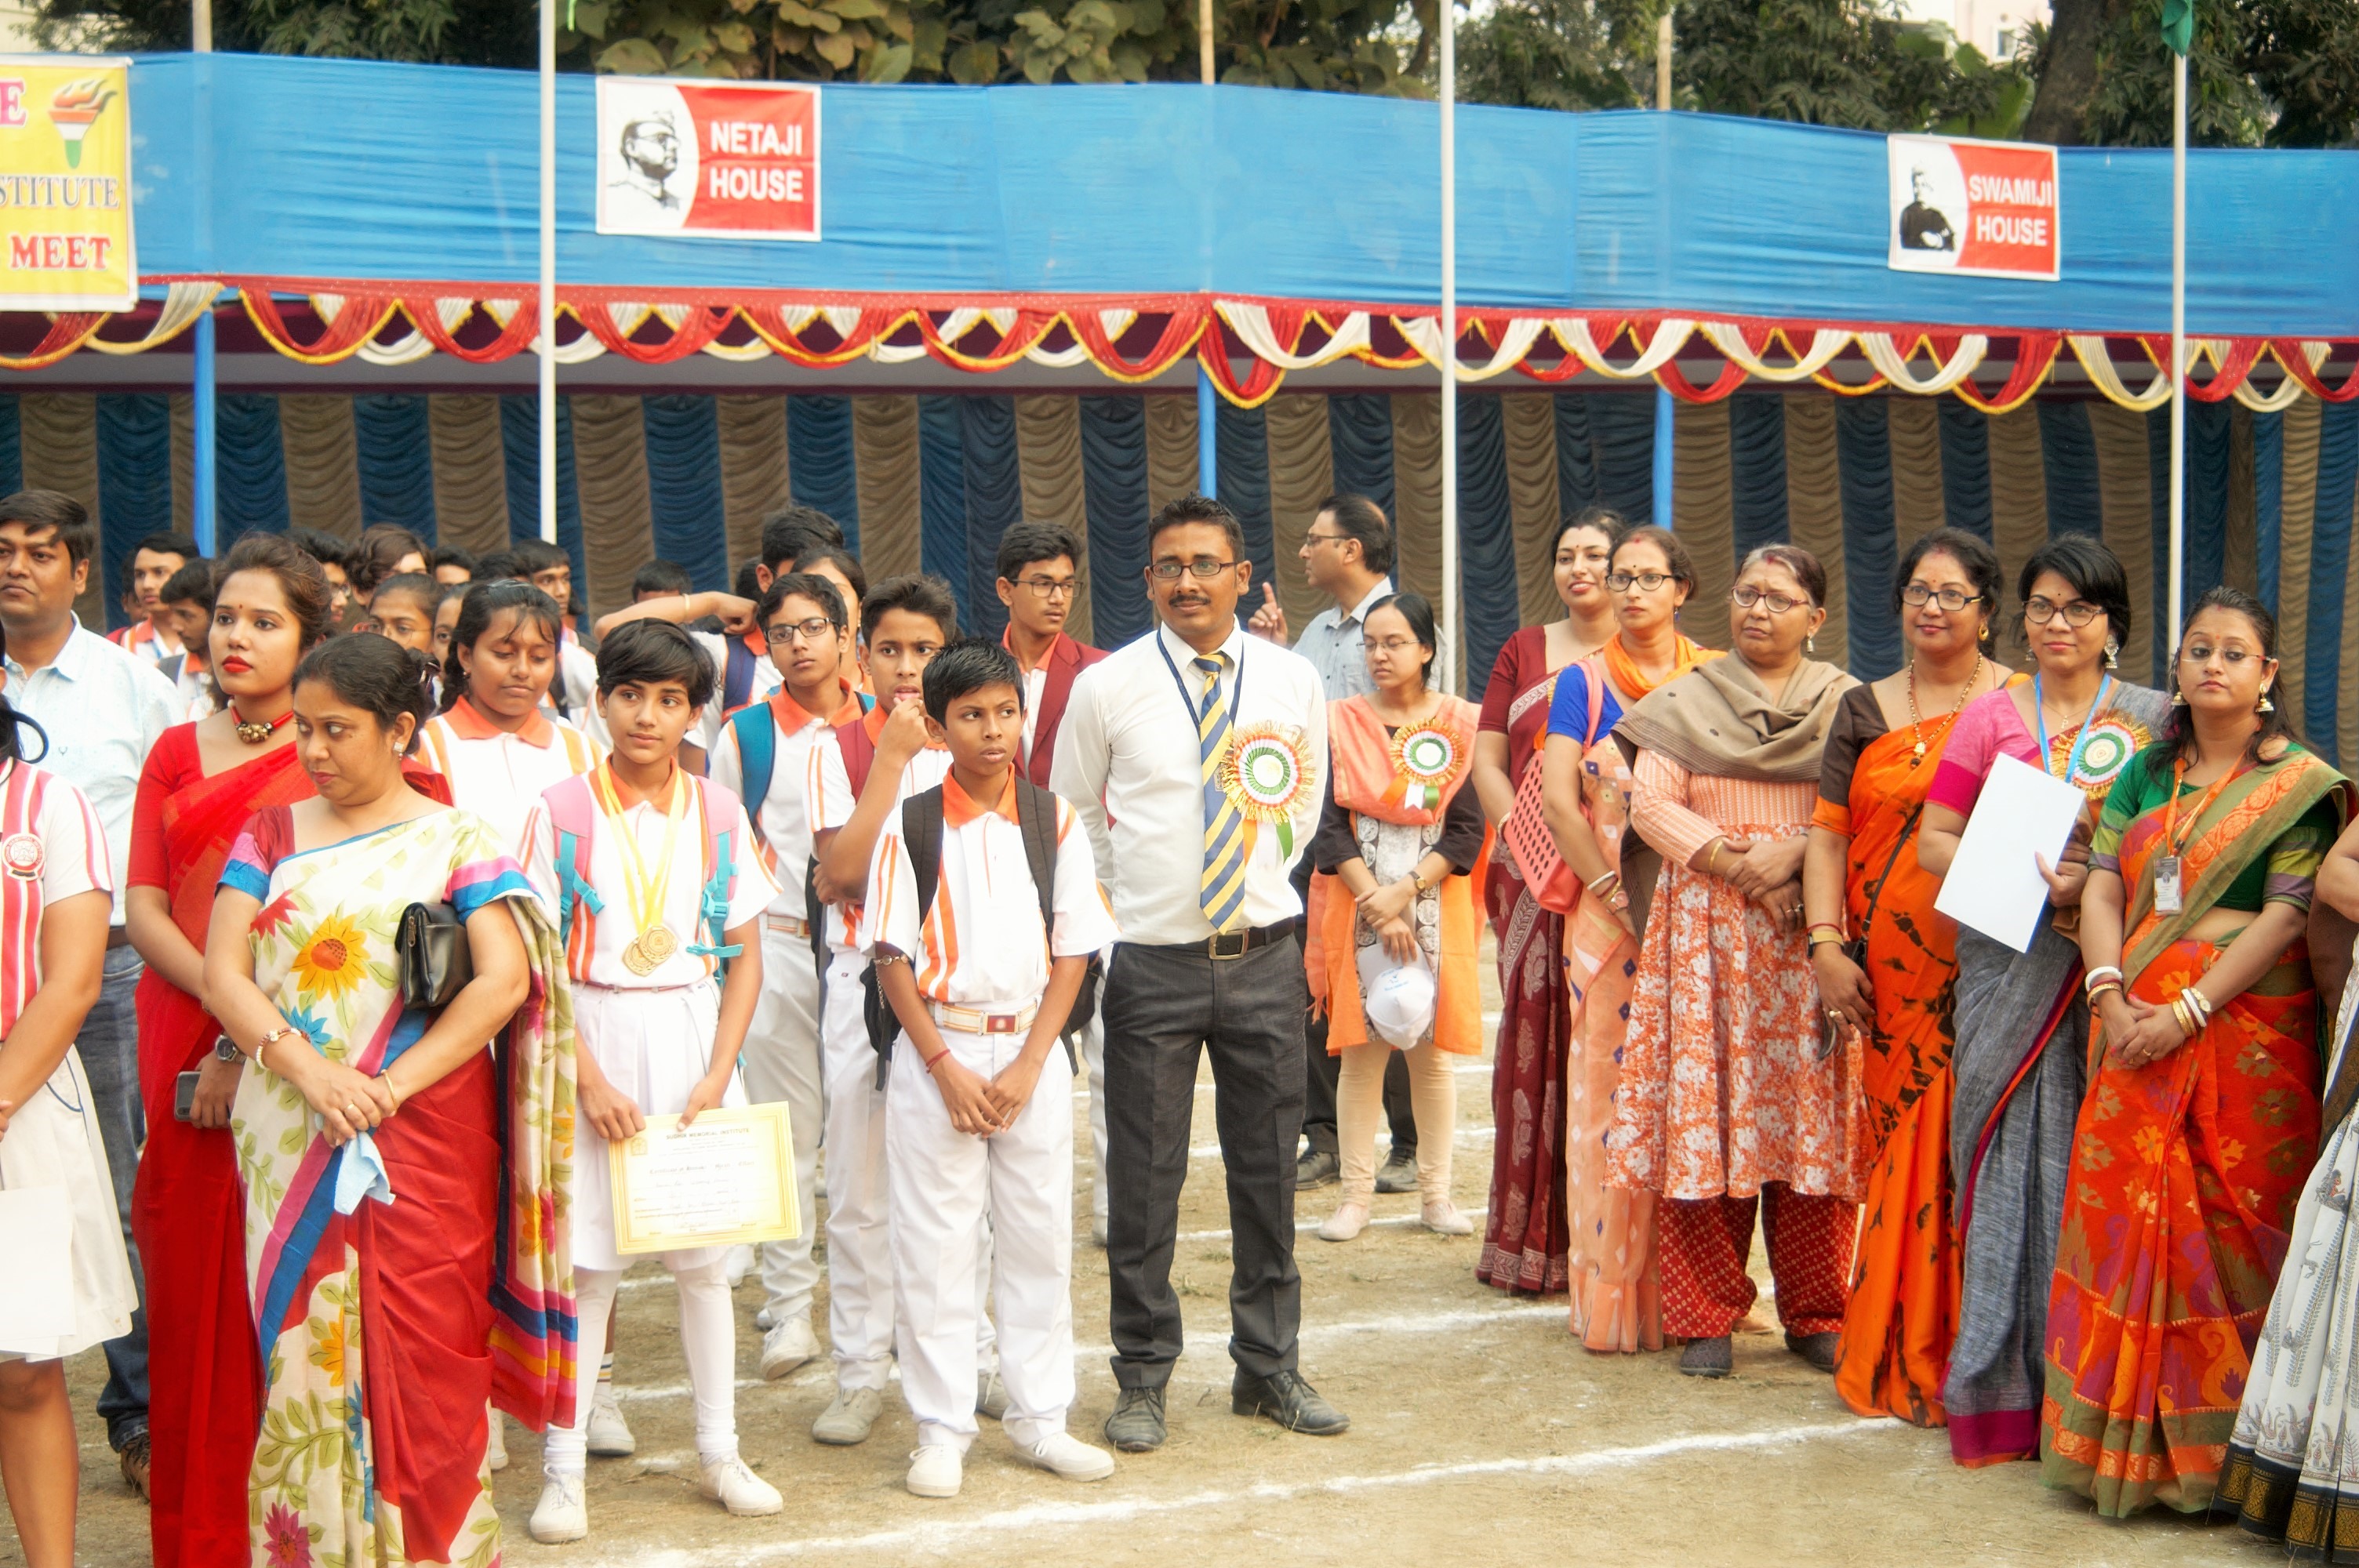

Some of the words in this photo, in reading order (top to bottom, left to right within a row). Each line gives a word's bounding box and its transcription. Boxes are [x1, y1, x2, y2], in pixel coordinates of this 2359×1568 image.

[710, 122, 802, 155] NETAJI
[710, 167, 804, 202] HOUSE
[1968, 174, 2052, 206] SWAMIJI
[1976, 214, 2047, 246] HOUSE
[10, 235, 111, 269] MEET
